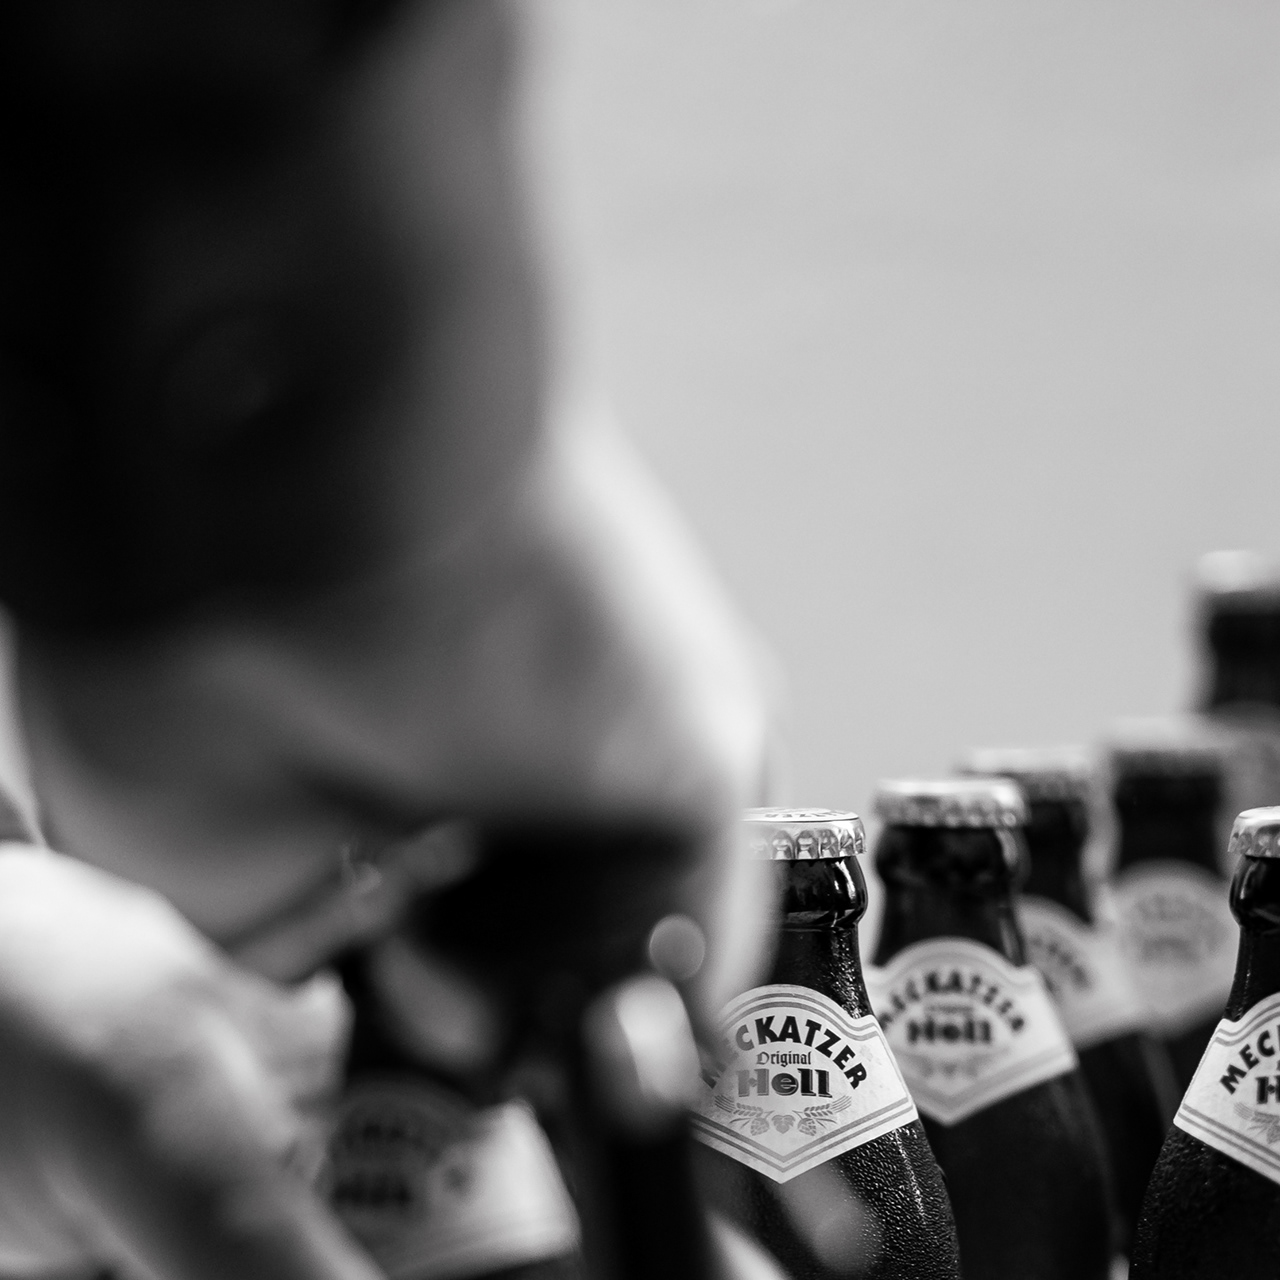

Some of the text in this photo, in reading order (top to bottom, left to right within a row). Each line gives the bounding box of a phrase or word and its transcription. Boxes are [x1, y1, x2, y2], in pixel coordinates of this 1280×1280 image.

[701, 1015, 867, 1089] CKATZER
[756, 1051, 811, 1067] Original
[736, 1068, 832, 1098] Hell
